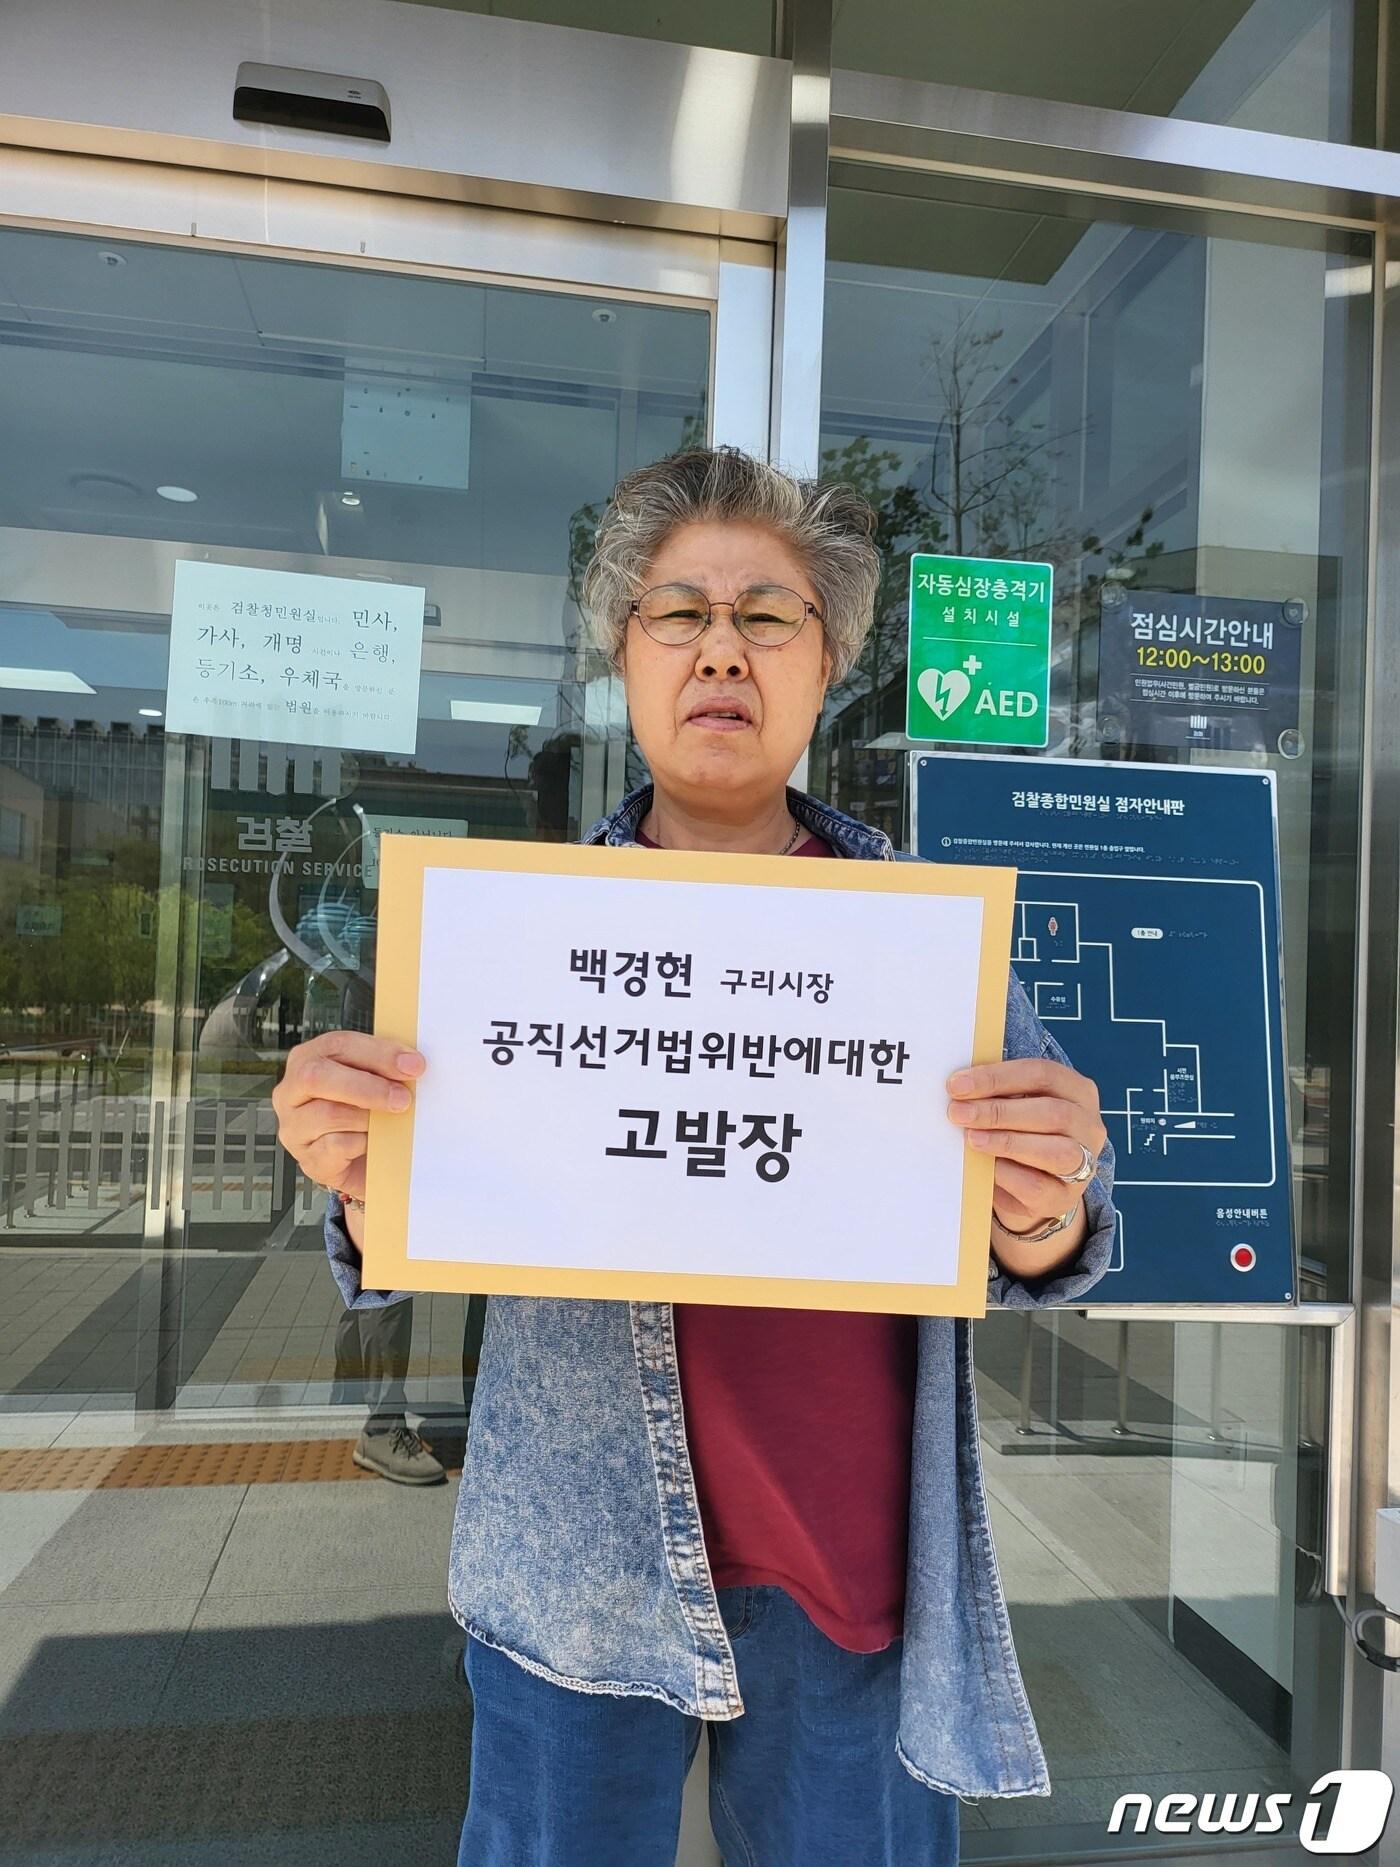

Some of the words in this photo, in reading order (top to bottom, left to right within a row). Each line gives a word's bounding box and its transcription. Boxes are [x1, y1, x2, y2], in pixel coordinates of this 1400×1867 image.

[917, 573, 1045, 603] 자동심장충격기
[353, 609, 397, 632] 민사,
[1130, 612, 1274, 650] 점심시간안내
[197, 625, 245, 649] 가사,
[263, 632, 302, 655] 개명
[350, 641, 395, 664] 은행,
[195, 658, 265, 685] 등기소,
[1137, 646, 1265, 674] 12:00~13:00
[974, 689, 1038, 718] AED
[1012, 791, 1111, 812] 검찰종합민원실
[1115, 797, 1185, 816] 점자안내판
[236, 816, 313, 853] 검찰
[569, 949, 693, 998] 백경현
[720, 968, 835, 1004] 구리시장
[482, 1020, 910, 1085] 공직선거법위반에대한
[605, 1108, 803, 1183] 고발장
[1216, 1208, 1268, 1219] 음성안내버튼
